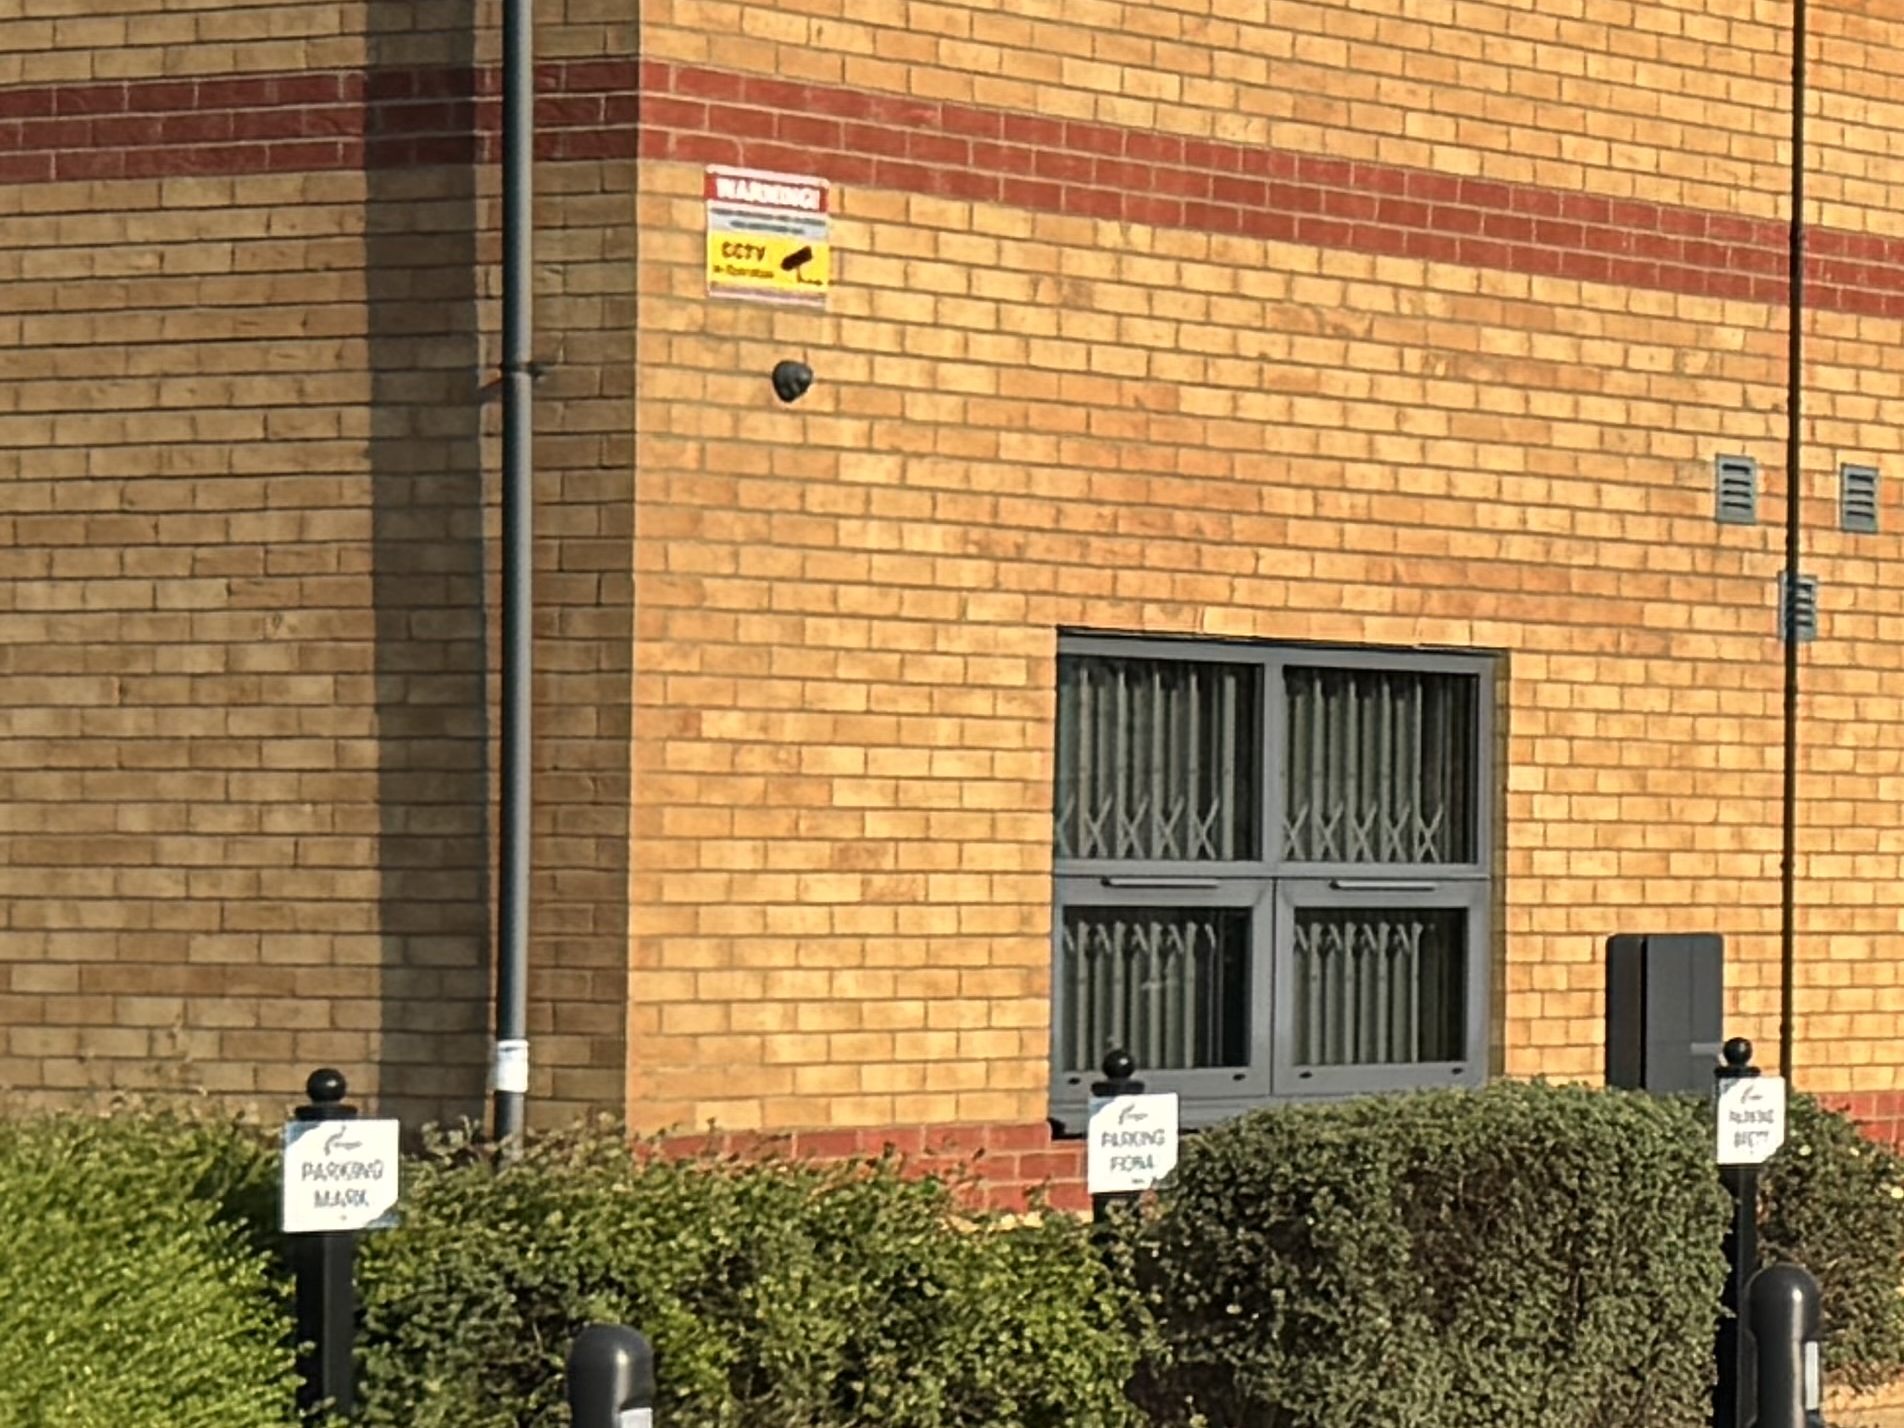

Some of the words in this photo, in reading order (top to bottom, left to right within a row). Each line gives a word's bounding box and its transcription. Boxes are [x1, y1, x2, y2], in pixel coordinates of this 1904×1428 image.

[721, 241, 766, 262] CCTV
[1100, 1128, 1166, 1148] PARKING
[301, 1159, 385, 1182] PARKING
[314, 1187, 370, 1209] MARK
